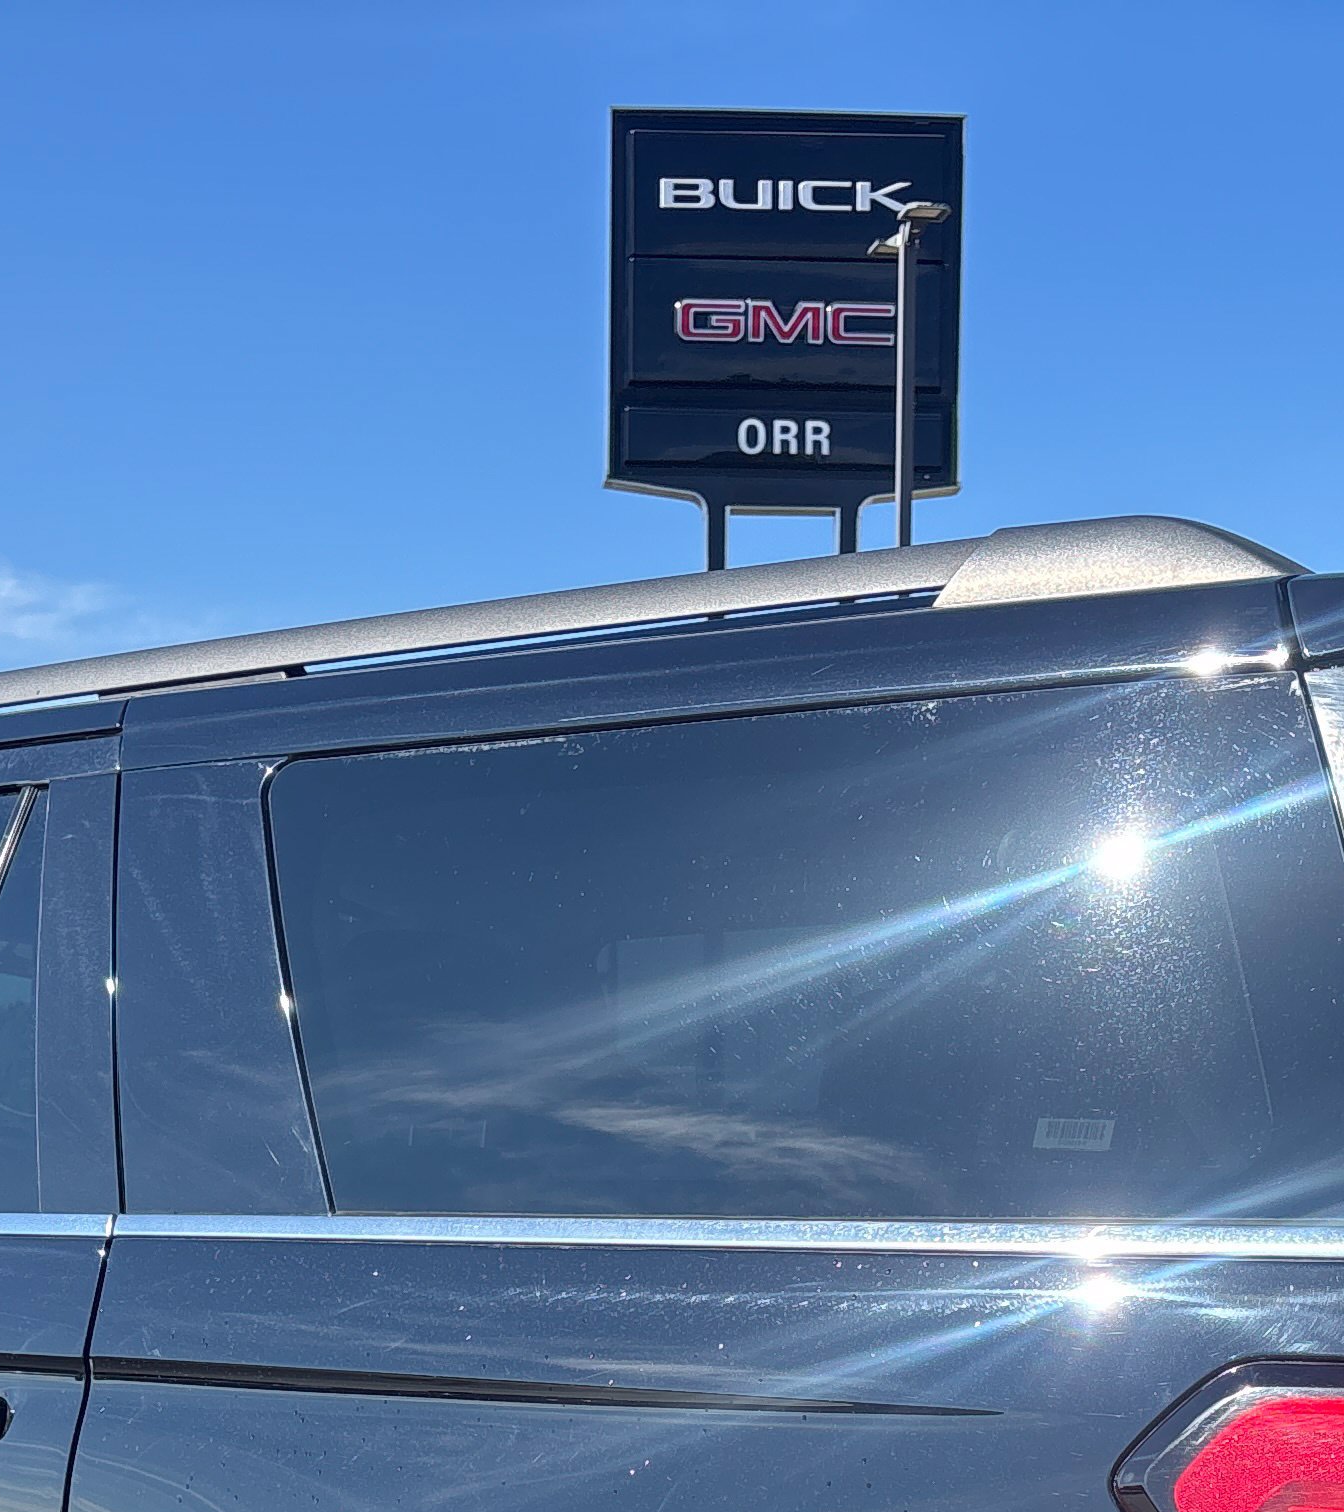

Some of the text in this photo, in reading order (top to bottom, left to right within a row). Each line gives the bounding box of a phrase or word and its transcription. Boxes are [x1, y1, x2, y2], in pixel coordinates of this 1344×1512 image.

[659, 178, 914, 213] BUICK
[674, 297, 896, 347] GMC
[736, 418, 832, 456] ORR
